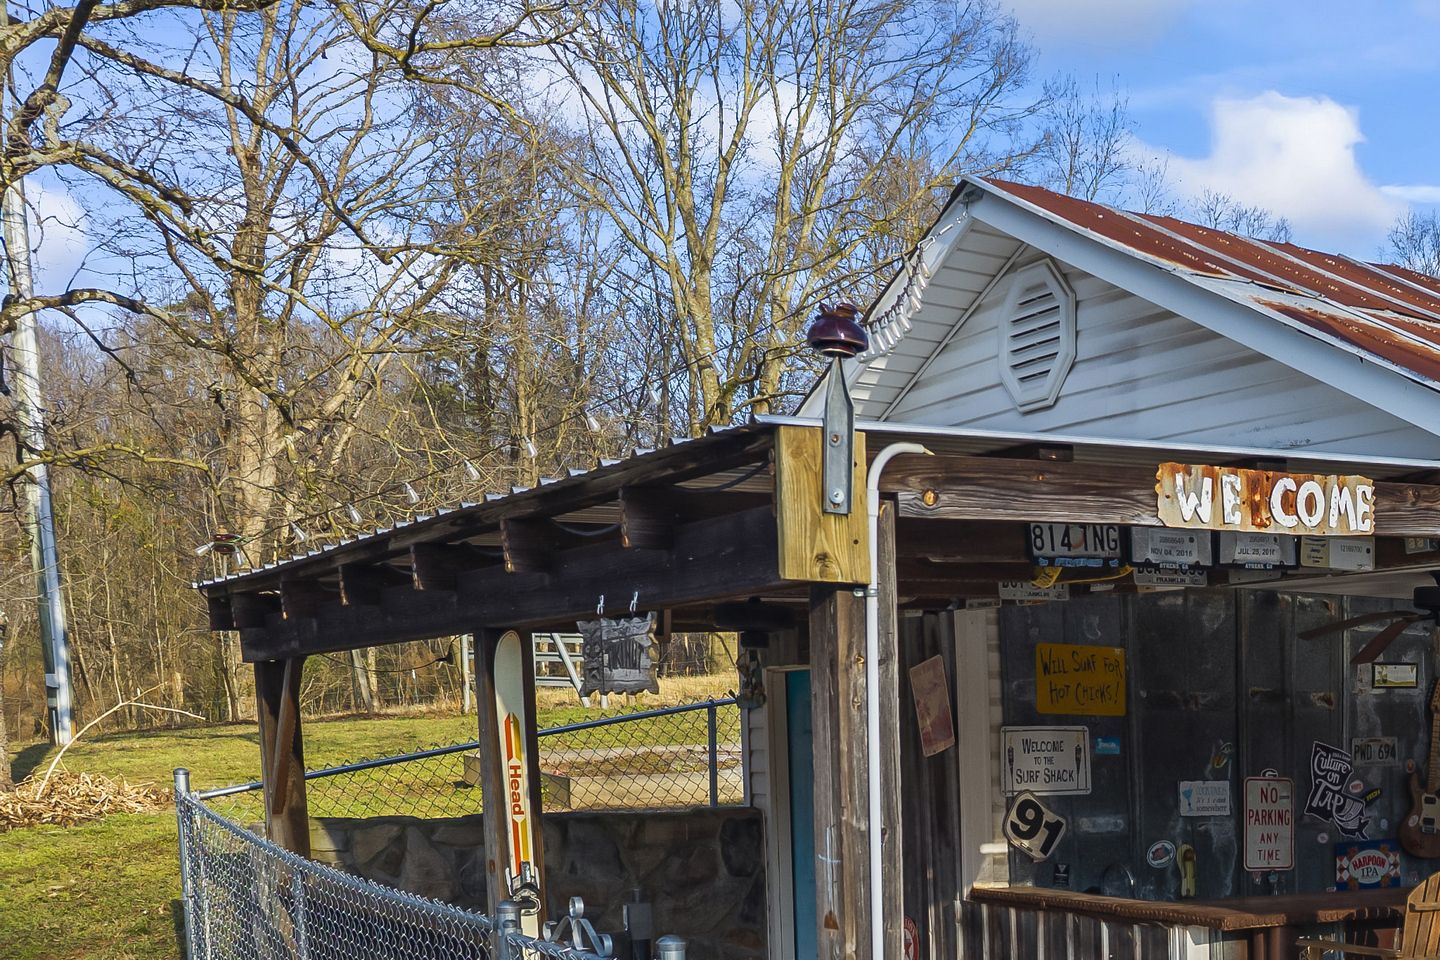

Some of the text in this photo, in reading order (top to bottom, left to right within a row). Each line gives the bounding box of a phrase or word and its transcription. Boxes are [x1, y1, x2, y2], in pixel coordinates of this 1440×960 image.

[1032, 524, 1072, 552] 814
[1150, 547, 1163, 555] NOV
[1176, 549, 1193, 557] 2016
[1039, 648, 1068, 677] WILL
[1103, 658, 1122, 679] FOR
[1050, 681, 1071, 704] HOT
[1022, 738, 1065, 755] WELCOME
[1378, 743, 1397, 760] 694
[1033, 756, 1055, 765] TO THE
[1313, 747, 1351, 776] Culture
[1015, 768, 1075, 784] SURF SHACK
[509, 764, 525, 816] Head
[1260, 787, 1278, 804] NO
[1248, 809, 1291, 826] PARKING
[1010, 799, 1064, 856] 91
[1259, 832, 1279, 844] ANY
[1258, 849, 1281, 861] TIME
[1351, 855, 1386, 871] HARPOON
[1361, 867, 1379, 877] IPA
